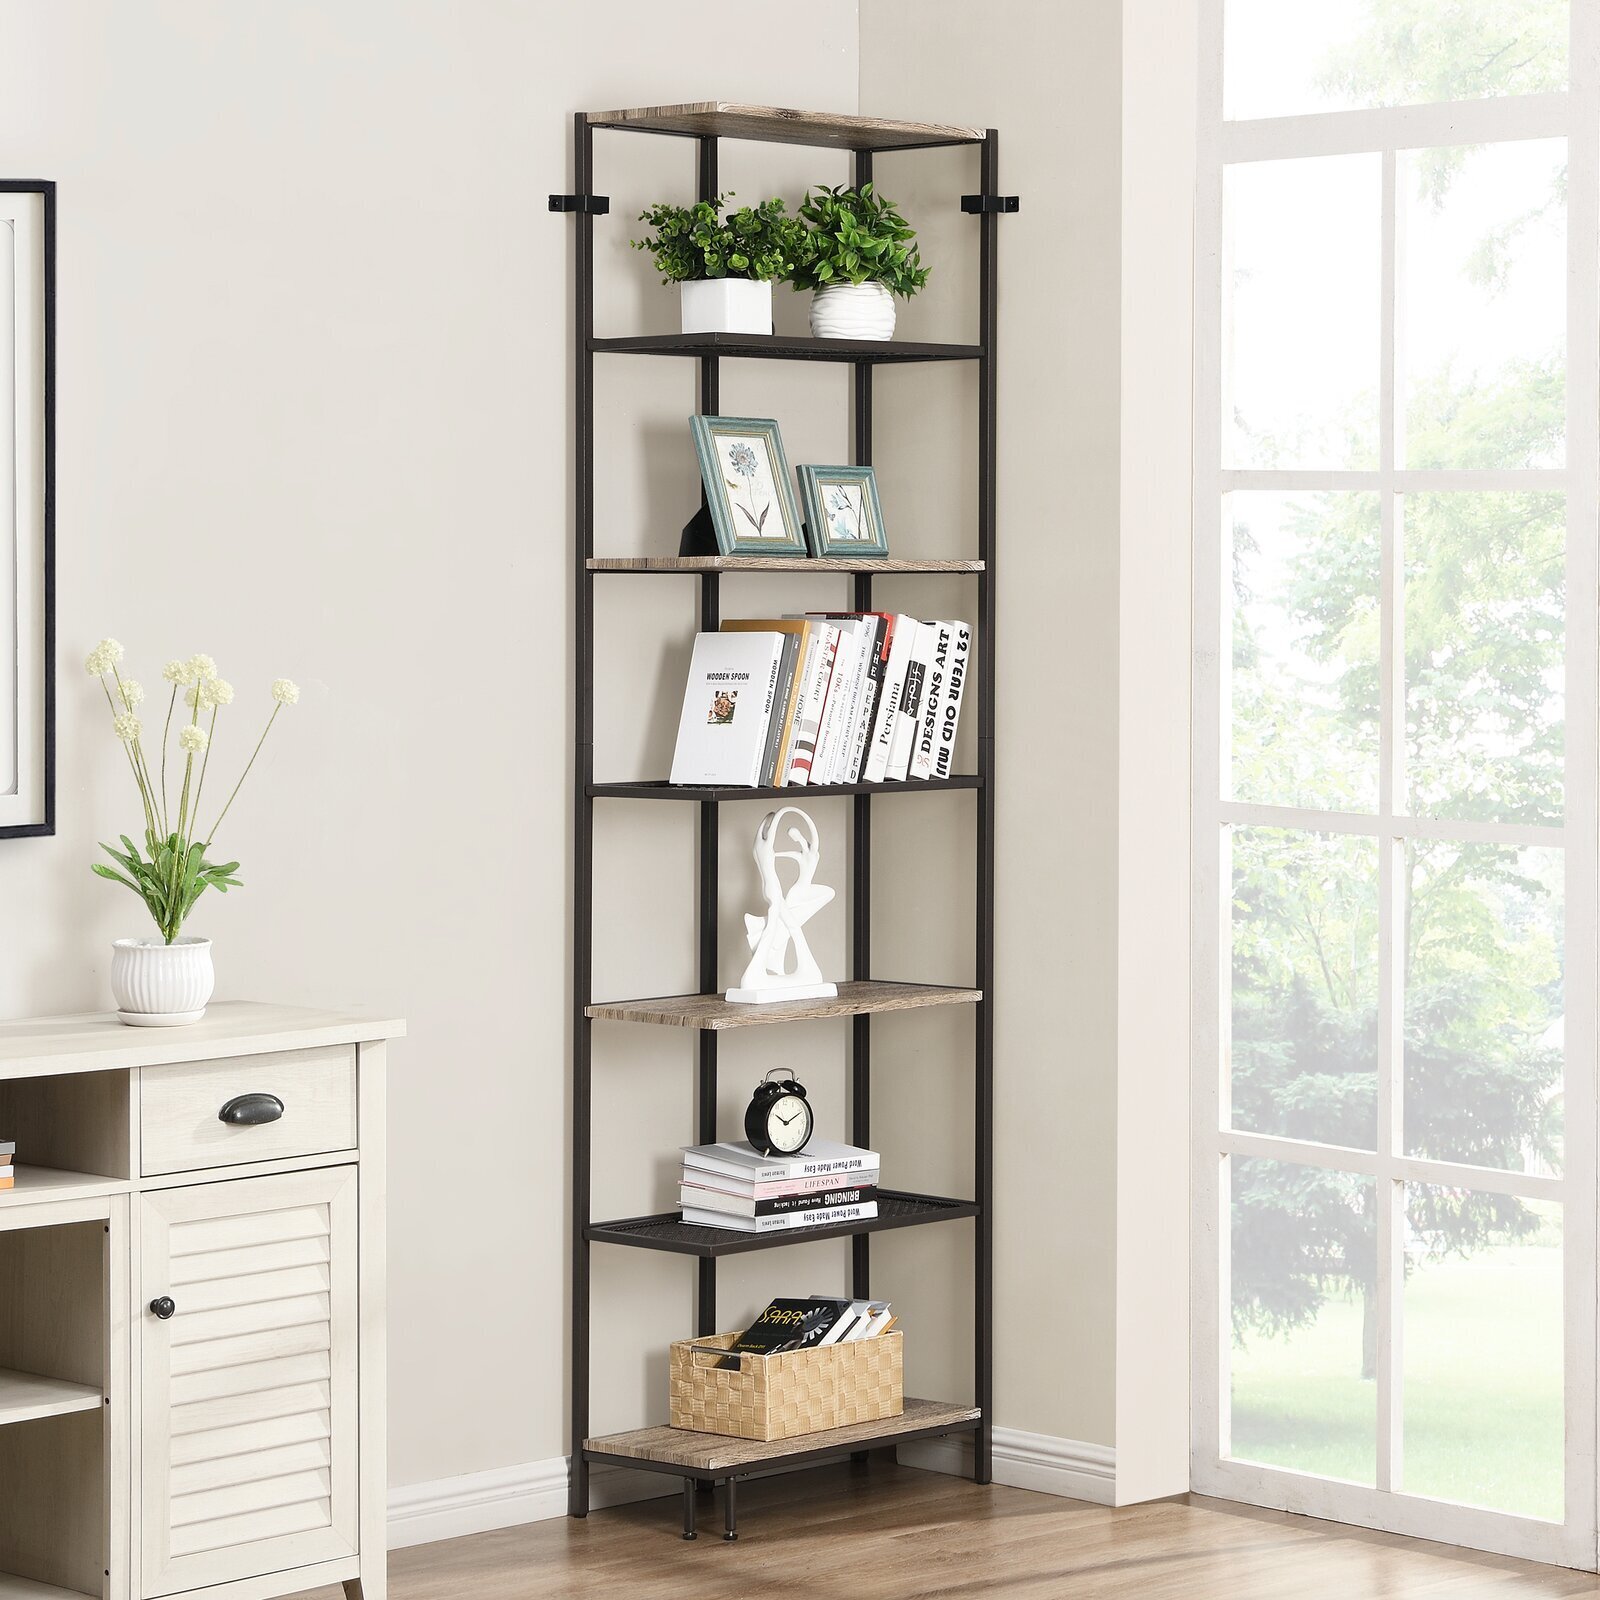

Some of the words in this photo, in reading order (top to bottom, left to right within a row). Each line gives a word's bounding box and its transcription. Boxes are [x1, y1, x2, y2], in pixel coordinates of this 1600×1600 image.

[820, 625, 834, 668] CRASTER
[957, 630, 970, 652] 52
[870, 640, 882, 677] THE
[706, 672, 730, 681] WOODEN
[731, 672, 750, 681] SPOON
[769, 659, 778, 688] WOODEN
[948, 658, 965, 701] YEAR
[814, 672, 824, 702] COURT
[921, 672, 942, 754] DESIGNS
[936, 629, 949, 669] ART
[764, 691, 773, 714] SPOON
[794, 694, 804, 726] HOME
[827, 699, 836, 728] Personal
[880, 682, 900, 745] Persiana
[850, 682, 874, 779] DEPARTED
[942, 706, 956, 742] OLD
[820, 730, 829, 758] Branding
[804, 1164, 816, 1174] Easy
[817, 1163, 831, 1172] Made
[832, 1161, 848, 1171] Power
[849, 1159, 862, 1168] Word
[804, 1178, 840, 1189] LIFESPAN
[798, 1198, 810, 1206] Found
[824, 1190, 860, 1205] BRINGING
[803, 1213, 815, 1222] Easy
[816, 1212, 830, 1220] Made
[831, 1209, 846, 1218] Power
[847, 1208, 860, 1216] Word
